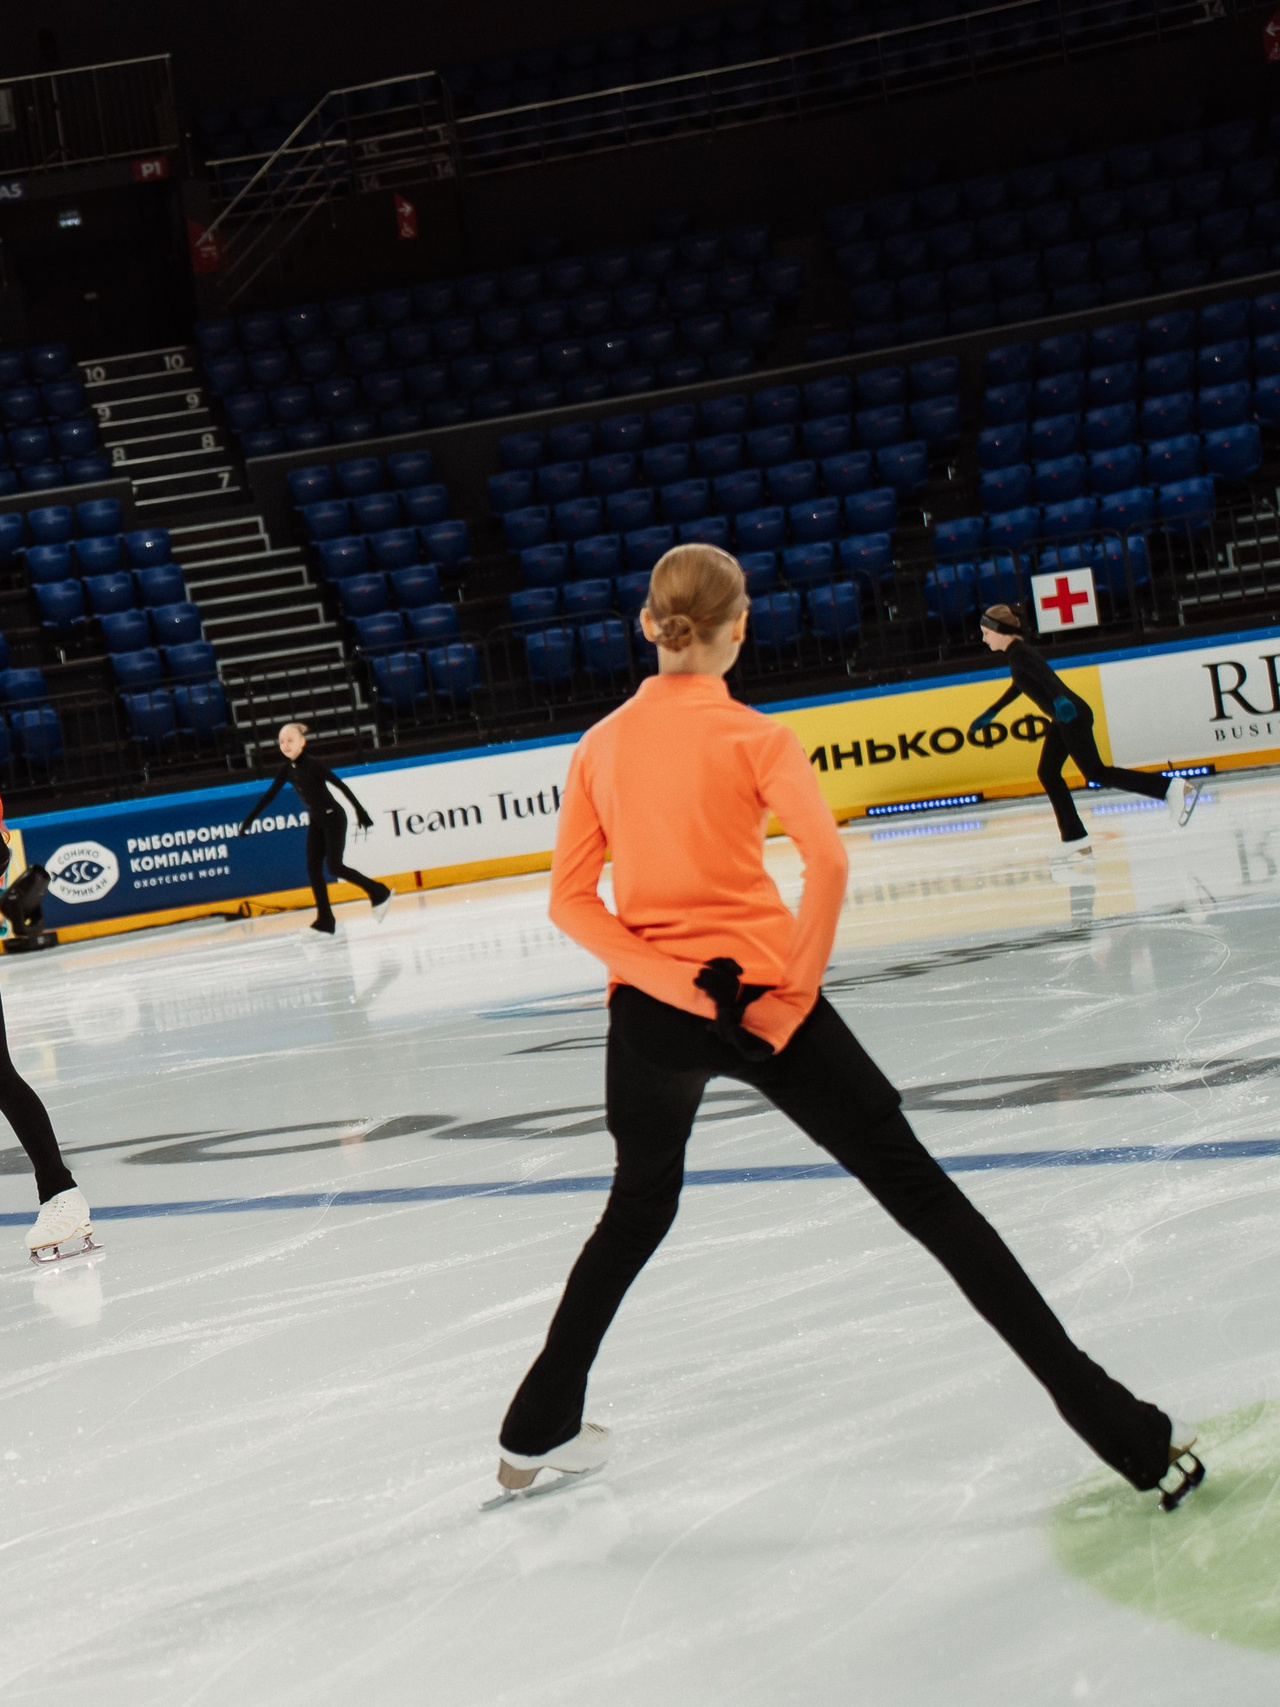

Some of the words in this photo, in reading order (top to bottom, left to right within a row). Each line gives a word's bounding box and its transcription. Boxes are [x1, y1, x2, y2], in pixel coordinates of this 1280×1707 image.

[163, 353, 185, 371] 10
[84, 365, 107, 382] 10
[186, 392, 200, 409] 9
[97, 406, 112, 422] 9
[201, 432, 216, 449] 8
[217, 471, 231, 489] 7
[383, 804, 483, 838] Team
[129, 843, 229, 874] КОМПАНИЯ
[133, 871, 195, 890] ОХОТСКОЕ
[198, 865, 231, 880] МОРЕ
